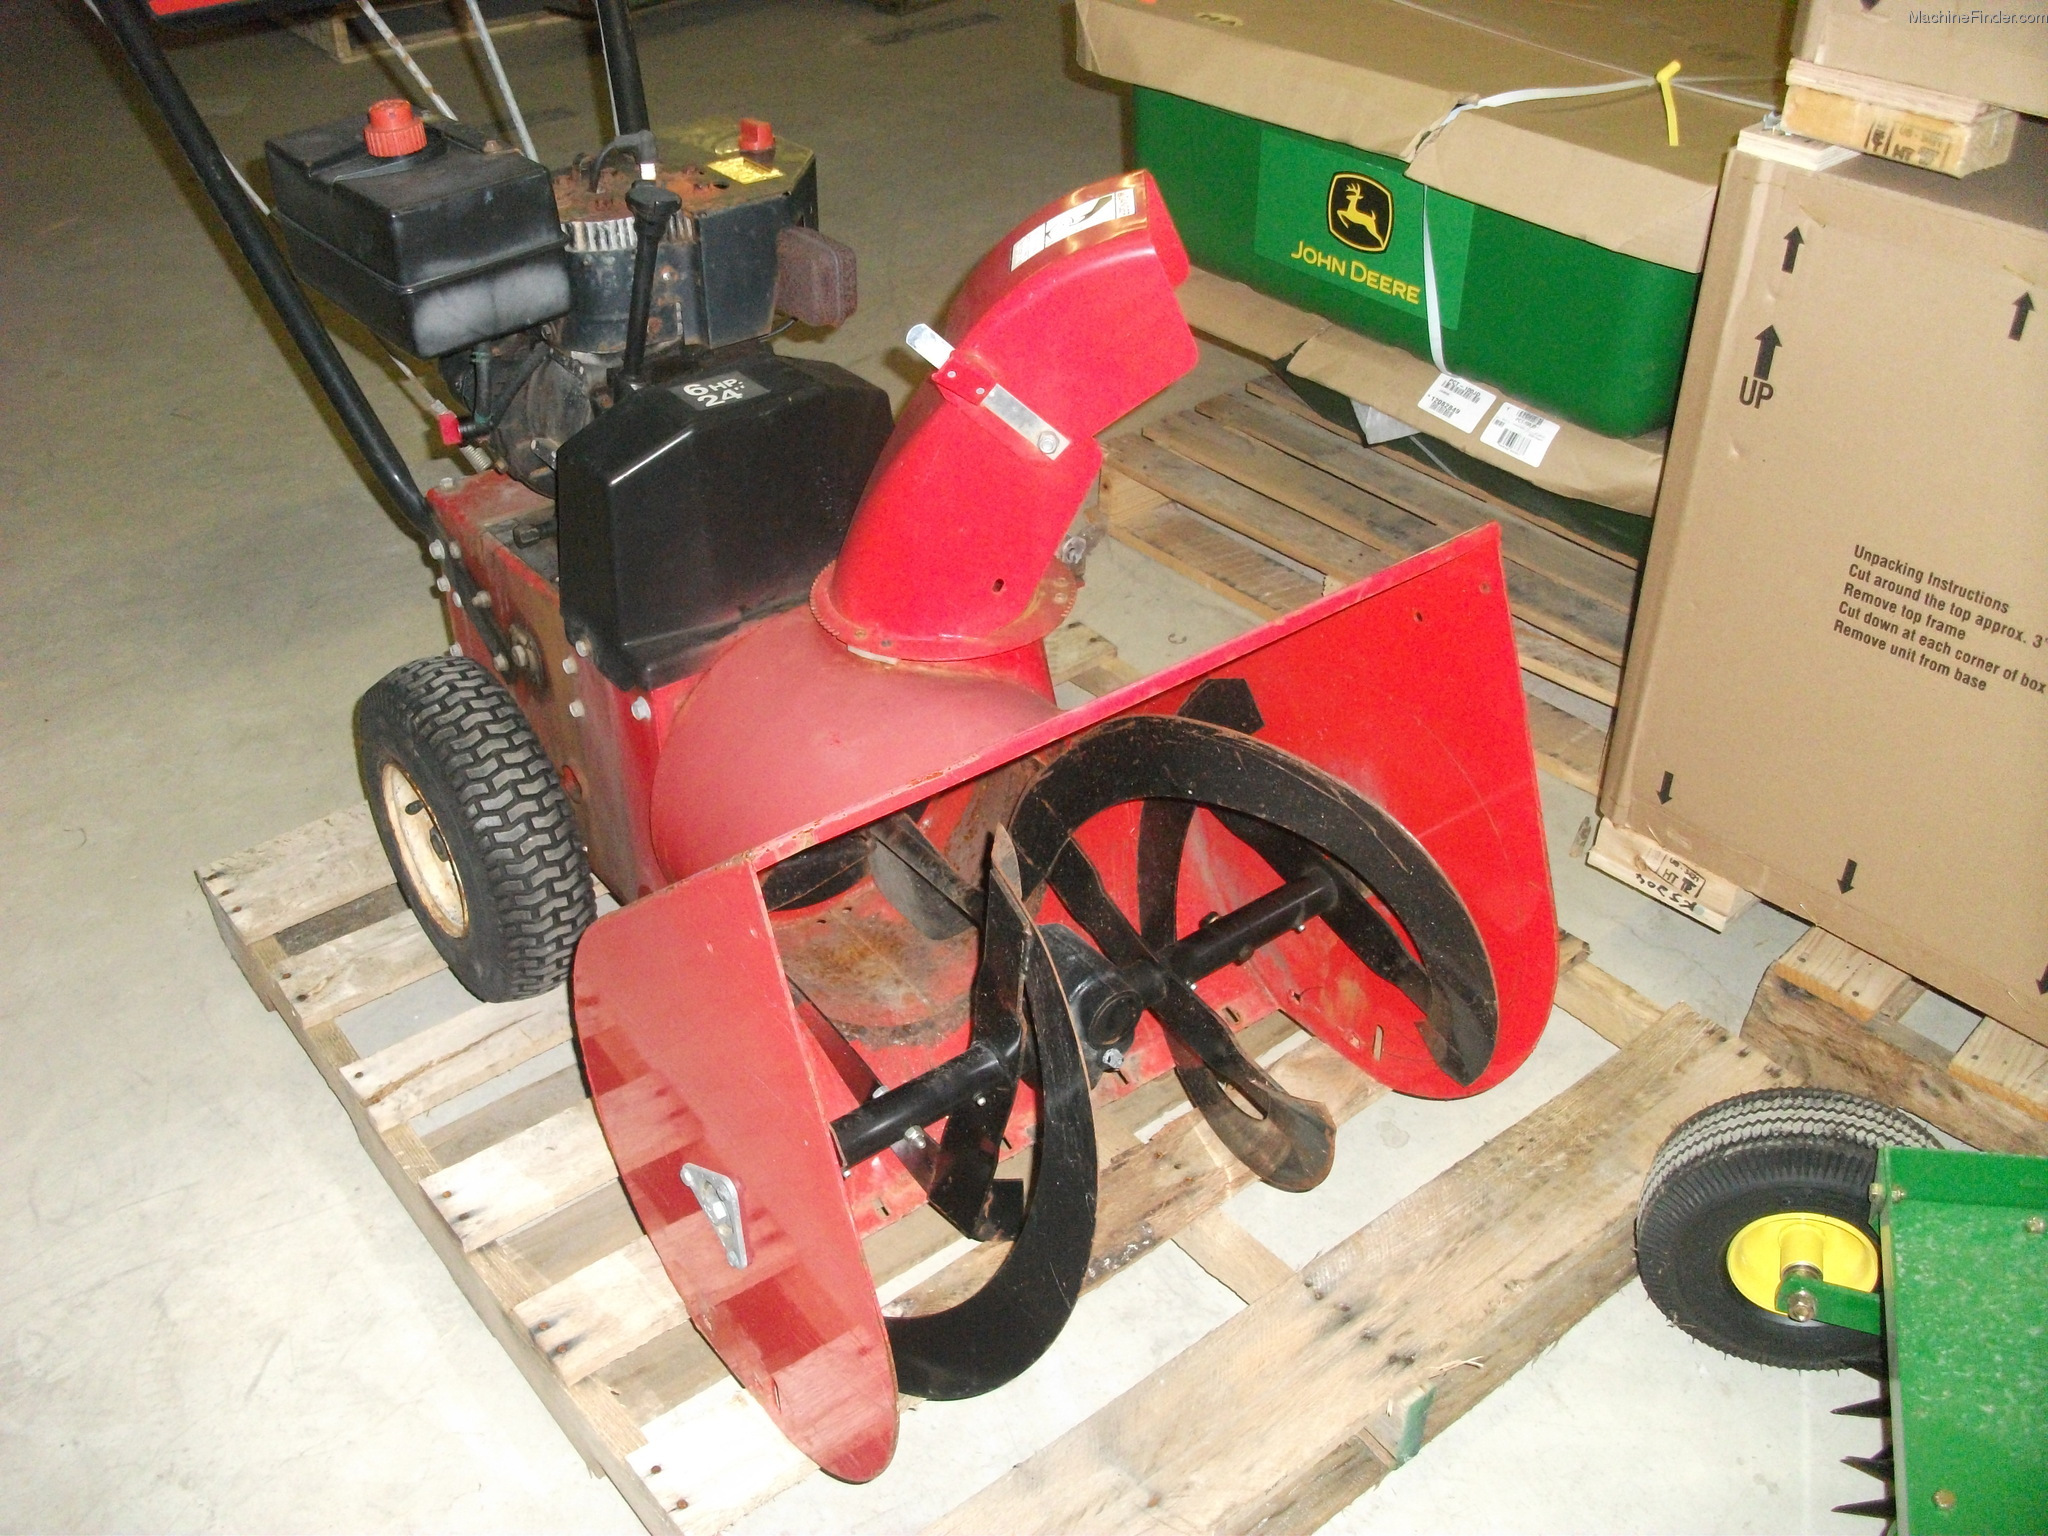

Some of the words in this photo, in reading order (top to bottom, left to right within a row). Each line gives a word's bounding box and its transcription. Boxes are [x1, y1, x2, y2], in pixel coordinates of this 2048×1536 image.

[1291, 240, 1346, 277] JOHN
[1350, 260, 1421, 305] DEERE
[683, 383, 709, 396] 6
[1739, 375, 1774, 409] UP
[1843, 582, 1898, 614] Remove
[1901, 604, 1923, 625] top
[1925, 614, 1967, 640] frame
[1848, 563, 1871, 583] Cut
[1873, 574, 1922, 602] around
[1924, 592, 1946, 611] the
[1949, 602, 1972, 622] top
[1974, 614, 2027, 644] approx.
[1853, 544, 1924, 584] Unpacking
[1927, 571, 2010, 614] Instructions
[1833, 619, 1887, 650] Remove
[1889, 643, 1918, 663] unit
[1918, 653, 1951, 677] from
[1953, 667, 1988, 692] base
[1838, 600, 1861, 620] Cut
[1863, 612, 1899, 635] down
[1902, 627, 1917, 642] at
[1918, 634, 1952, 656] each
[1954, 649, 2001, 675] corner
[2002, 668, 2019, 682] of
[2019, 672, 2047, 694] box
